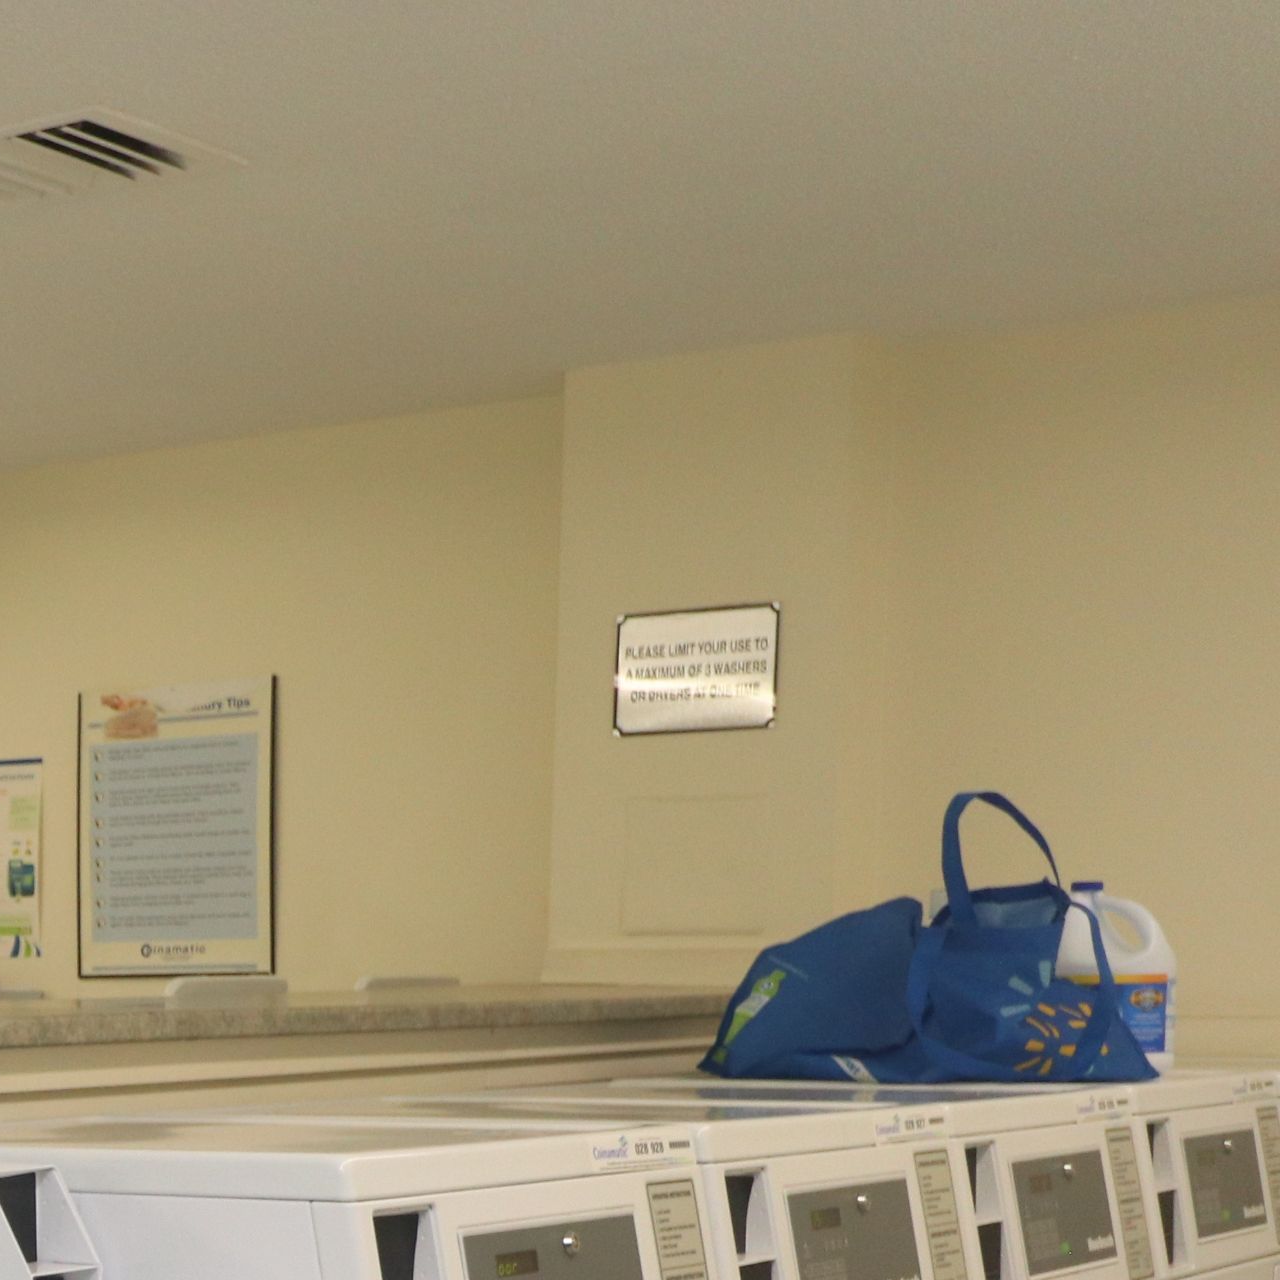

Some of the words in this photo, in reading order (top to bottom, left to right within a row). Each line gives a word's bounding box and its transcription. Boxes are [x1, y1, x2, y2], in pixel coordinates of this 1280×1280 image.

[625, 644, 665, 660] PLEASE
[668, 642, 695, 657] LIMIT
[698, 640, 727, 655] YOUR
[730, 638, 751, 653] USE
[754, 637, 769, 651] TO
[626, 667, 633, 679] A
[635, 664, 685, 680] MAXIMUM
[688, 664, 702, 677] OF
[714, 660, 768, 676] WASHERS
[227, 696, 250, 709] Tips
[635, 1142, 649, 1155] 028
[650, 1141, 664, 1154] 928
